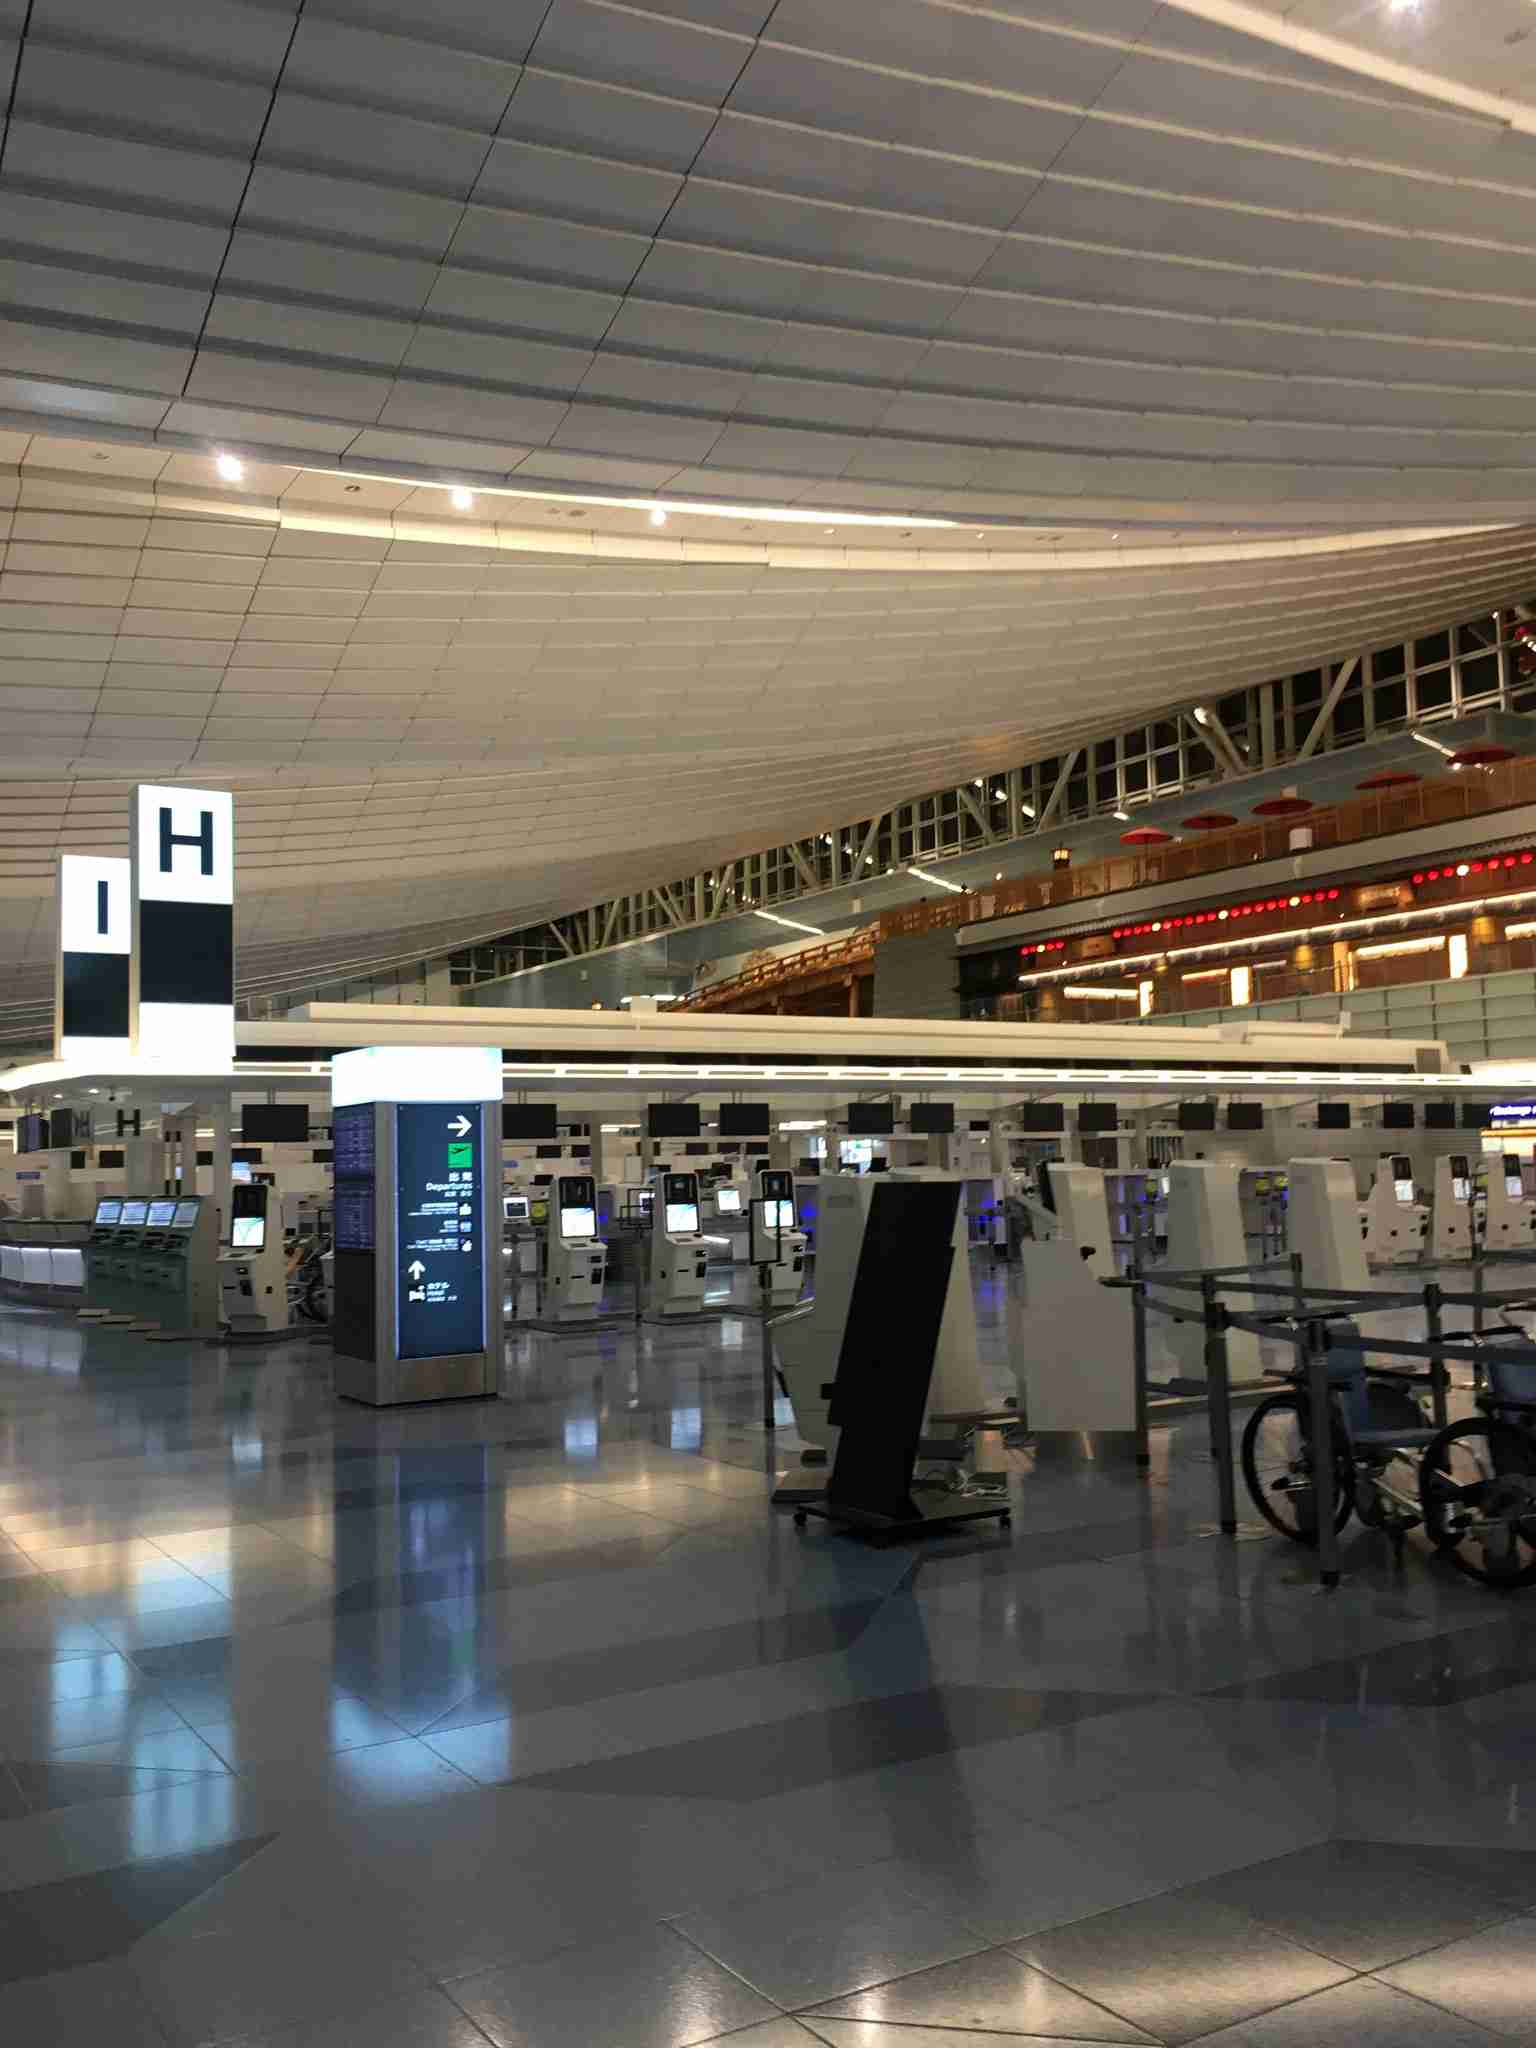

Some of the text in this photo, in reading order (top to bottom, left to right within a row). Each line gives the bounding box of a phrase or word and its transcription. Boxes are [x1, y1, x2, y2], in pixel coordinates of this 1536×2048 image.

[159, 807, 213, 875] H
[97, 880, 109, 935] I
[117, 1109, 140, 1136] H
[426, 1183, 473, 1192] Departures
